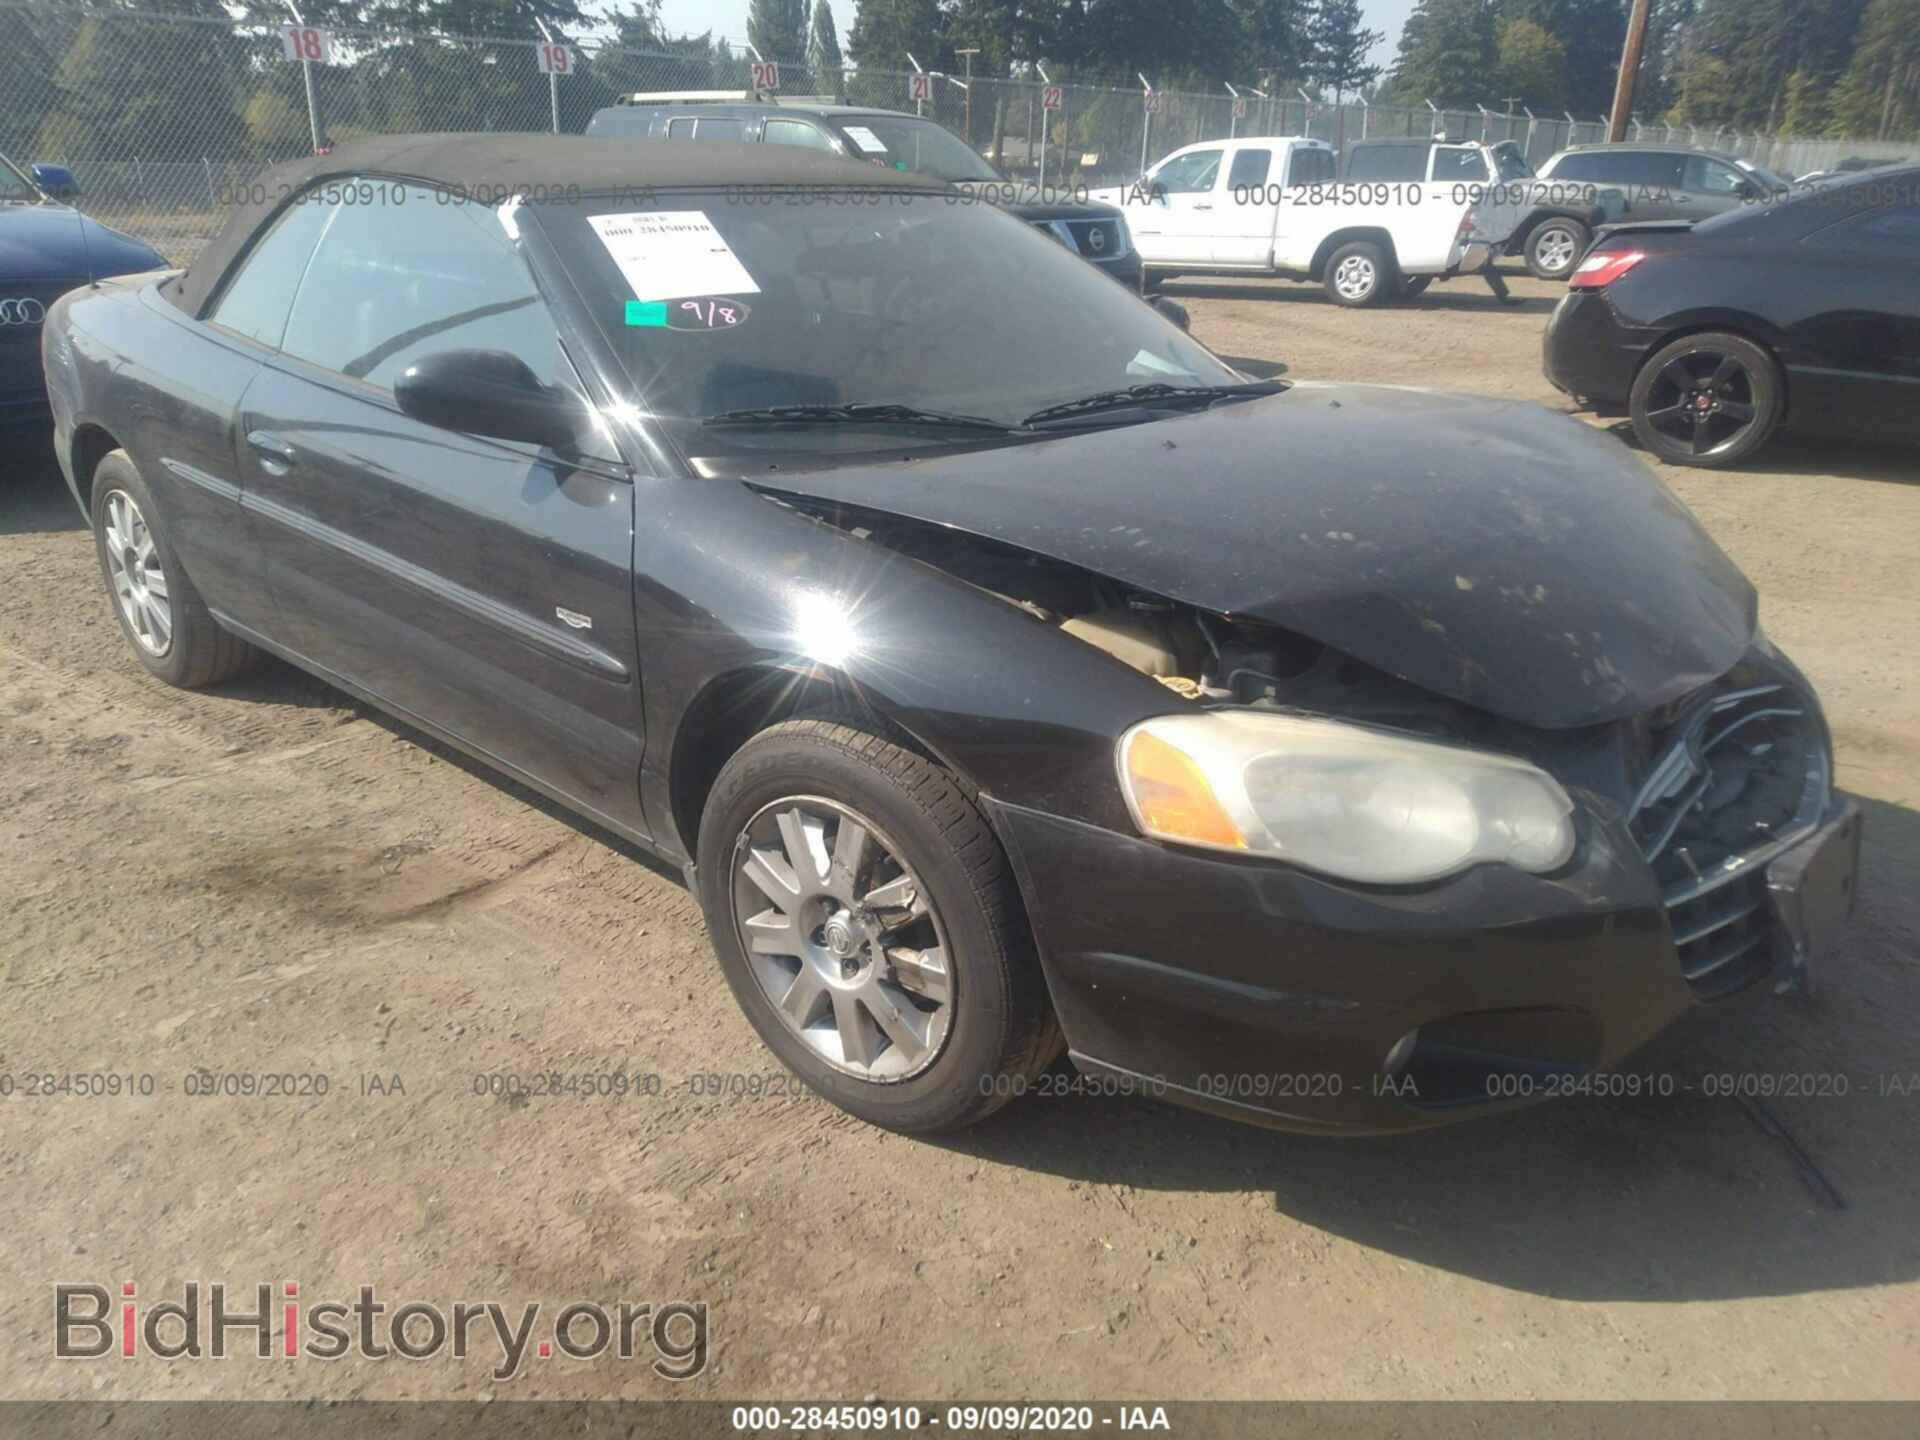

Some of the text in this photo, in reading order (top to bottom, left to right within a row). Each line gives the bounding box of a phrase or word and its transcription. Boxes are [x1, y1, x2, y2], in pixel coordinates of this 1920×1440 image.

[289, 29, 322, 60] 18
[543, 46, 568, 72] 19
[753, 65, 778, 89] 20
[913, 78, 930, 99] 21
[1043, 88, 1061, 107] 22
[681, 301, 737, 327] 9/8
